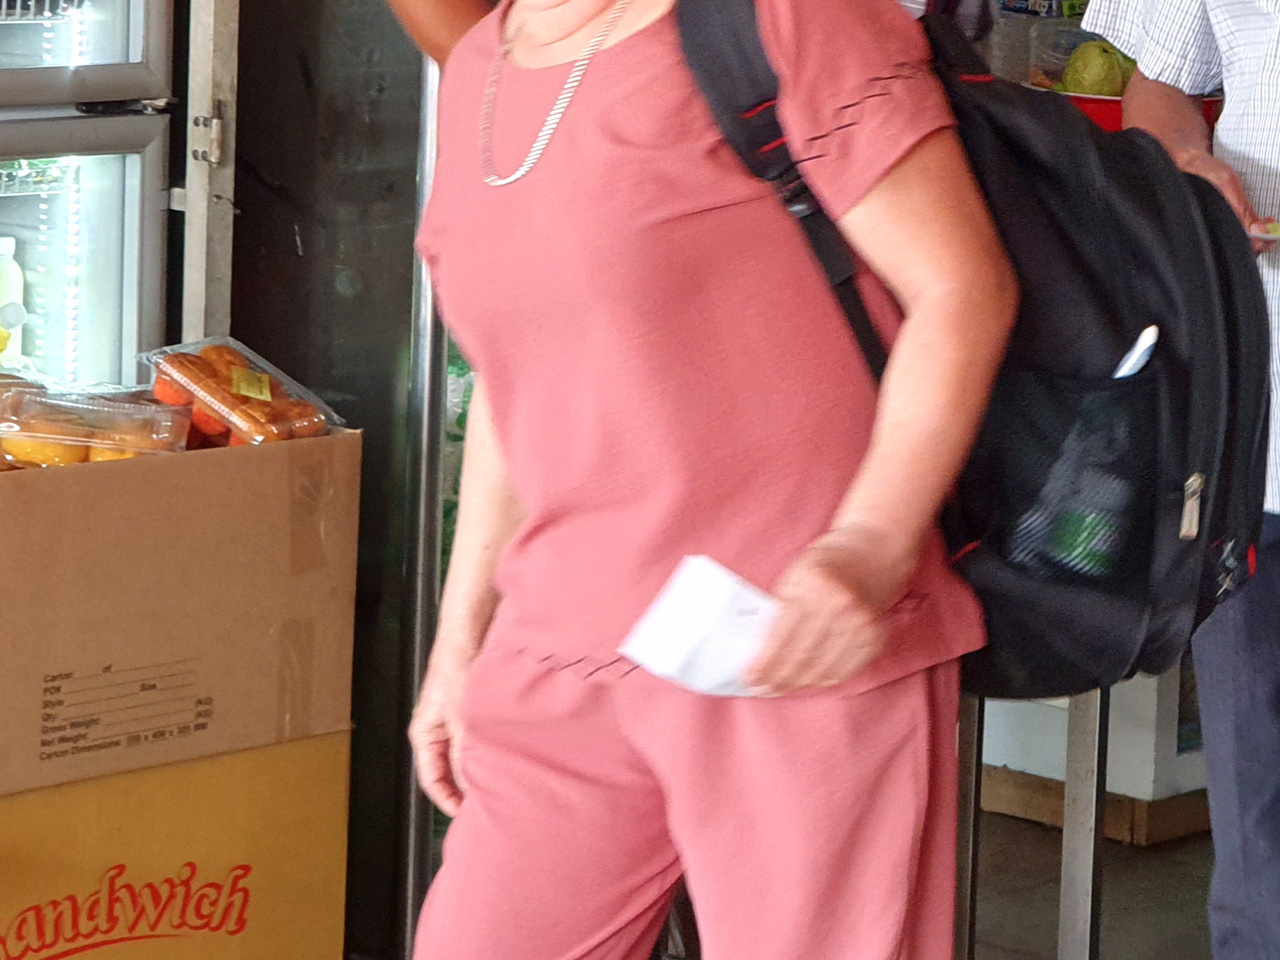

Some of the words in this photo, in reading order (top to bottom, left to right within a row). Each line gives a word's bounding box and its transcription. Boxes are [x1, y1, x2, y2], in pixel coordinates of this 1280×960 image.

[43, 673, 73, 683] Carton
[39, 749, 70, 761] Carton
[0, 861, 253, 960] andwich
